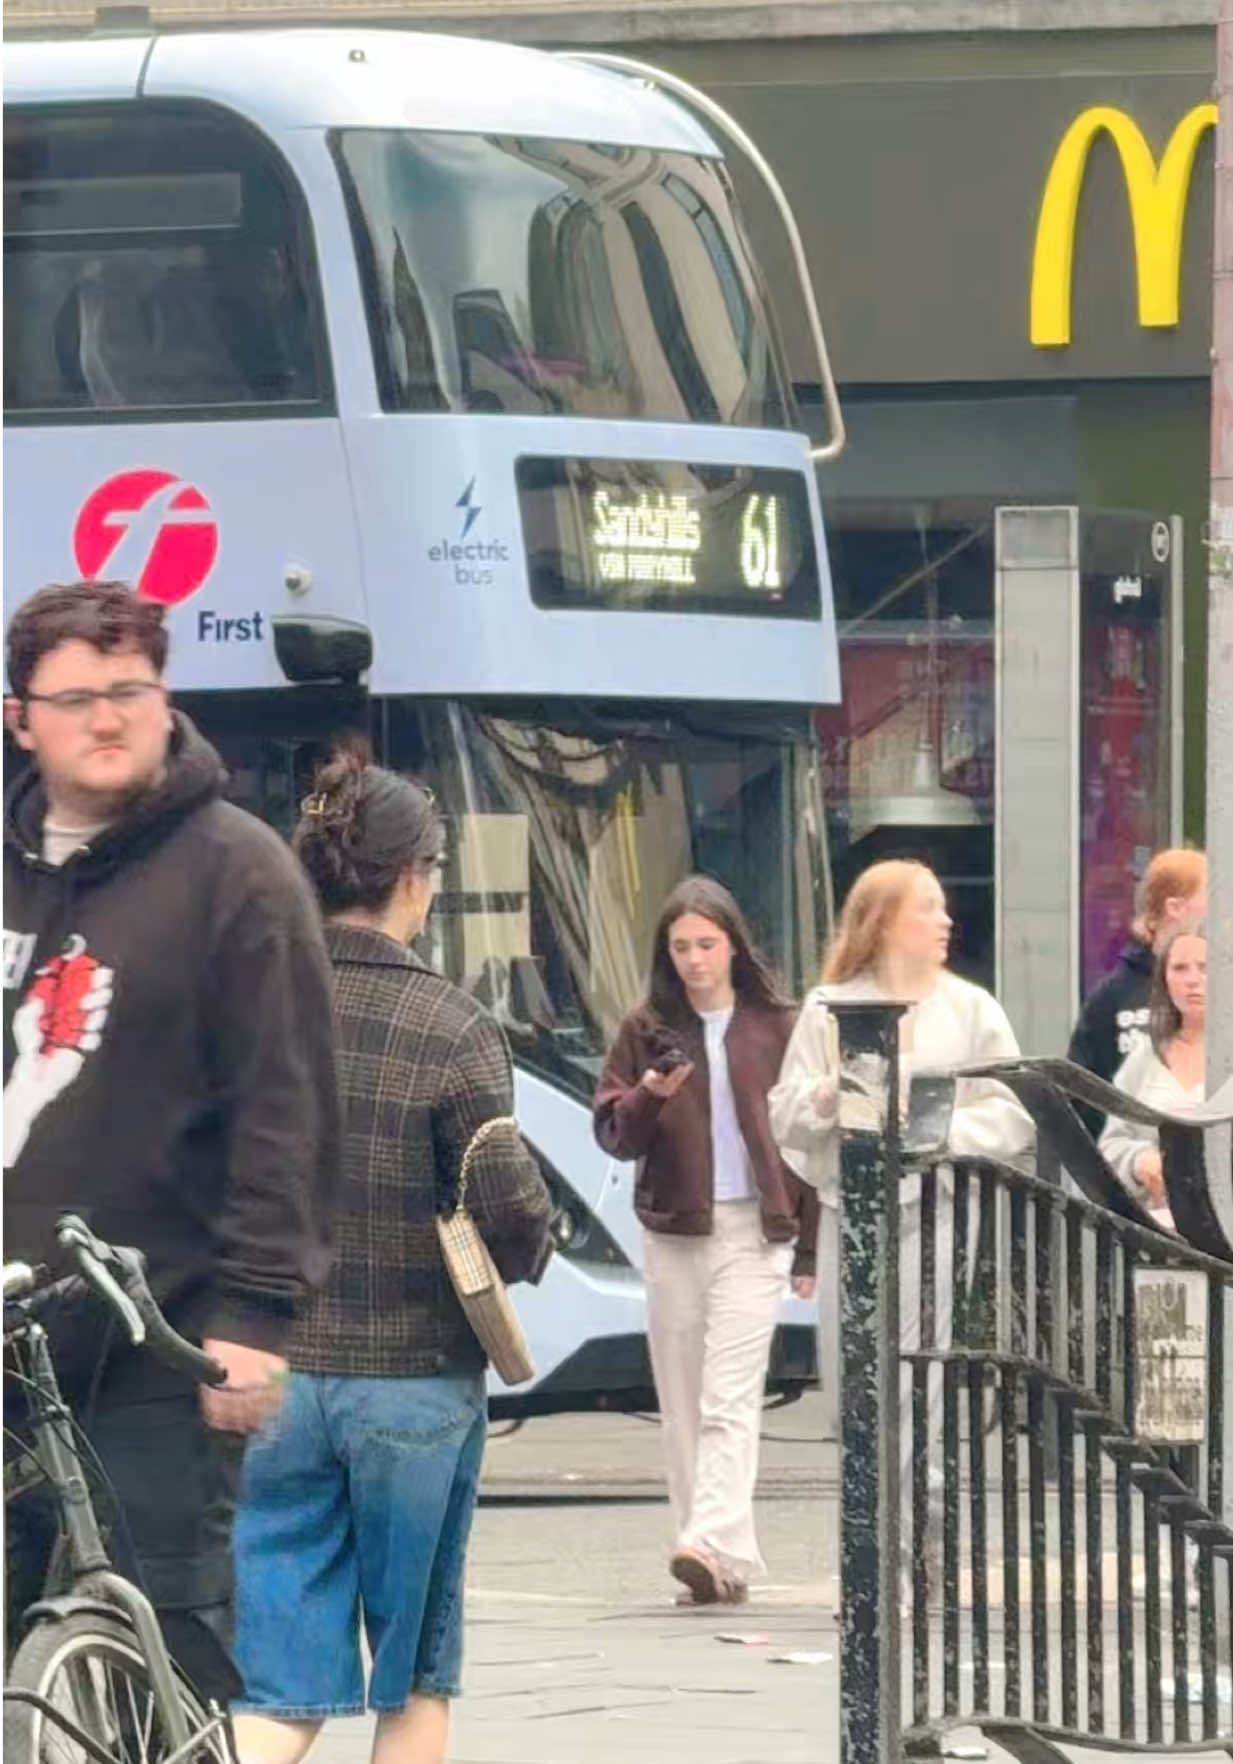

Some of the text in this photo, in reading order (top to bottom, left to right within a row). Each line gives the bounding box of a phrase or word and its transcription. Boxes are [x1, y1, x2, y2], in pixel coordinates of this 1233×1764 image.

[427, 538, 510, 562] electric
[741, 494, 779, 587] 61
[455, 563, 494, 585] bus
[198, 609, 264, 642] First
